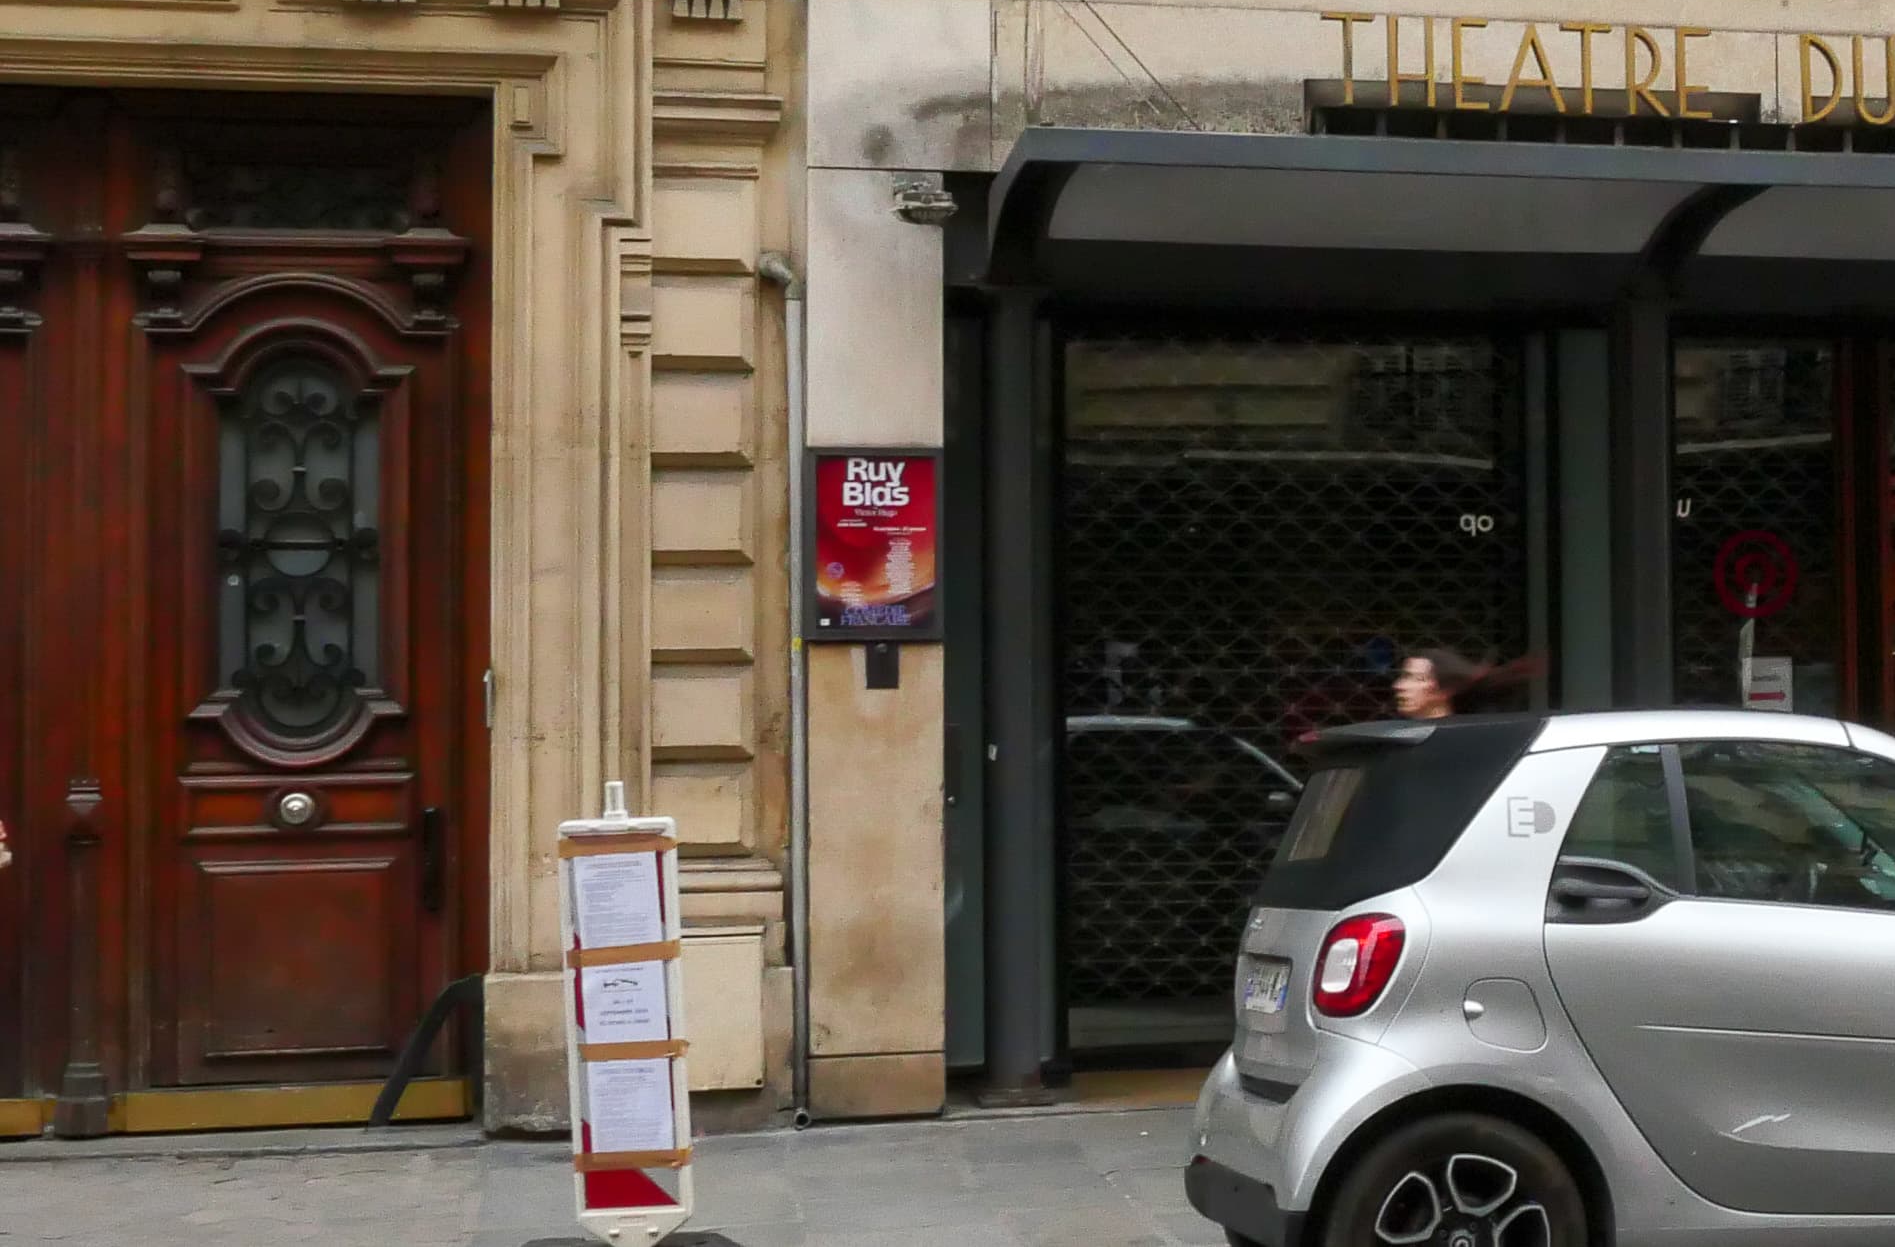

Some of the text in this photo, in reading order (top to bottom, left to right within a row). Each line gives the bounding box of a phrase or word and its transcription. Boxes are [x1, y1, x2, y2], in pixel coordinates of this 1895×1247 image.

[1320, 10, 1712, 120] THEATRE
[1799, 32, 1895, 126] DU
[847, 457, 905, 488] Ruy
[842, 482, 909, 507] Blas
